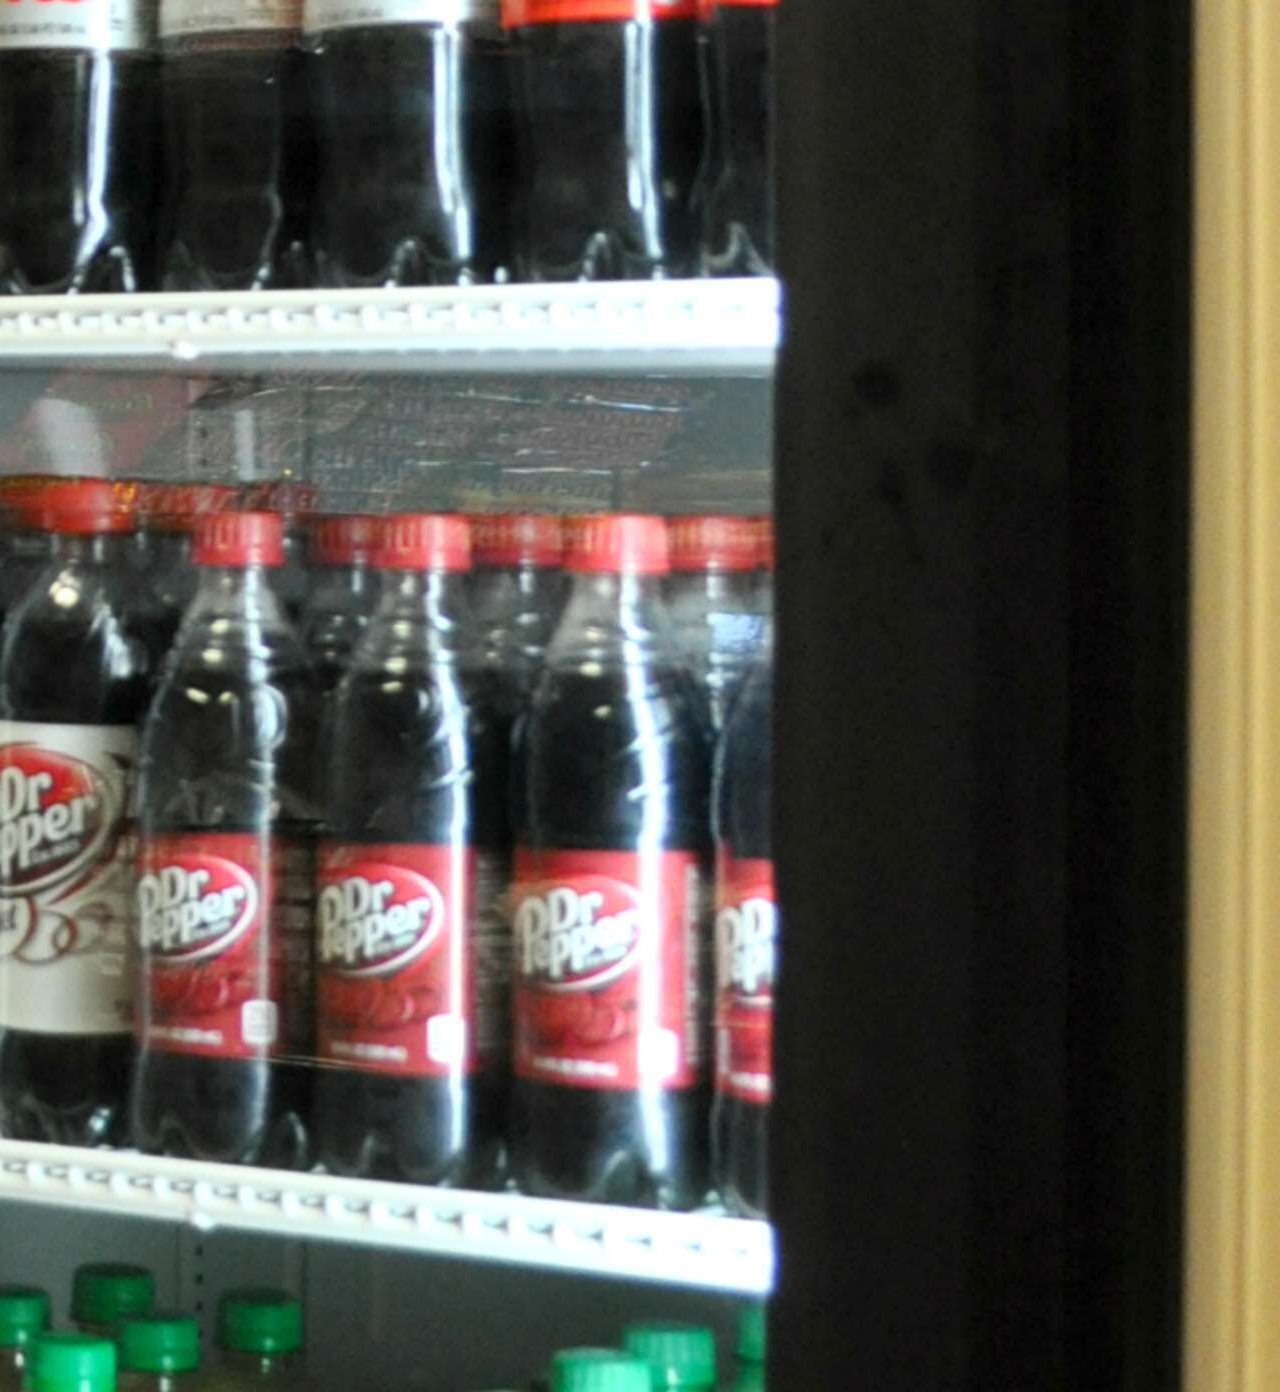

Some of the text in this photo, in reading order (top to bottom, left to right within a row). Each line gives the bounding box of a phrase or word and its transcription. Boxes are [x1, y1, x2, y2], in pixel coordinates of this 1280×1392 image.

[160, 864, 210, 906] Dr
[342, 875, 395, 920] Dr
[137, 873, 246, 950] Pepper
[318, 885, 431, 964] Pepper
[545, 886, 603, 936] Dr
